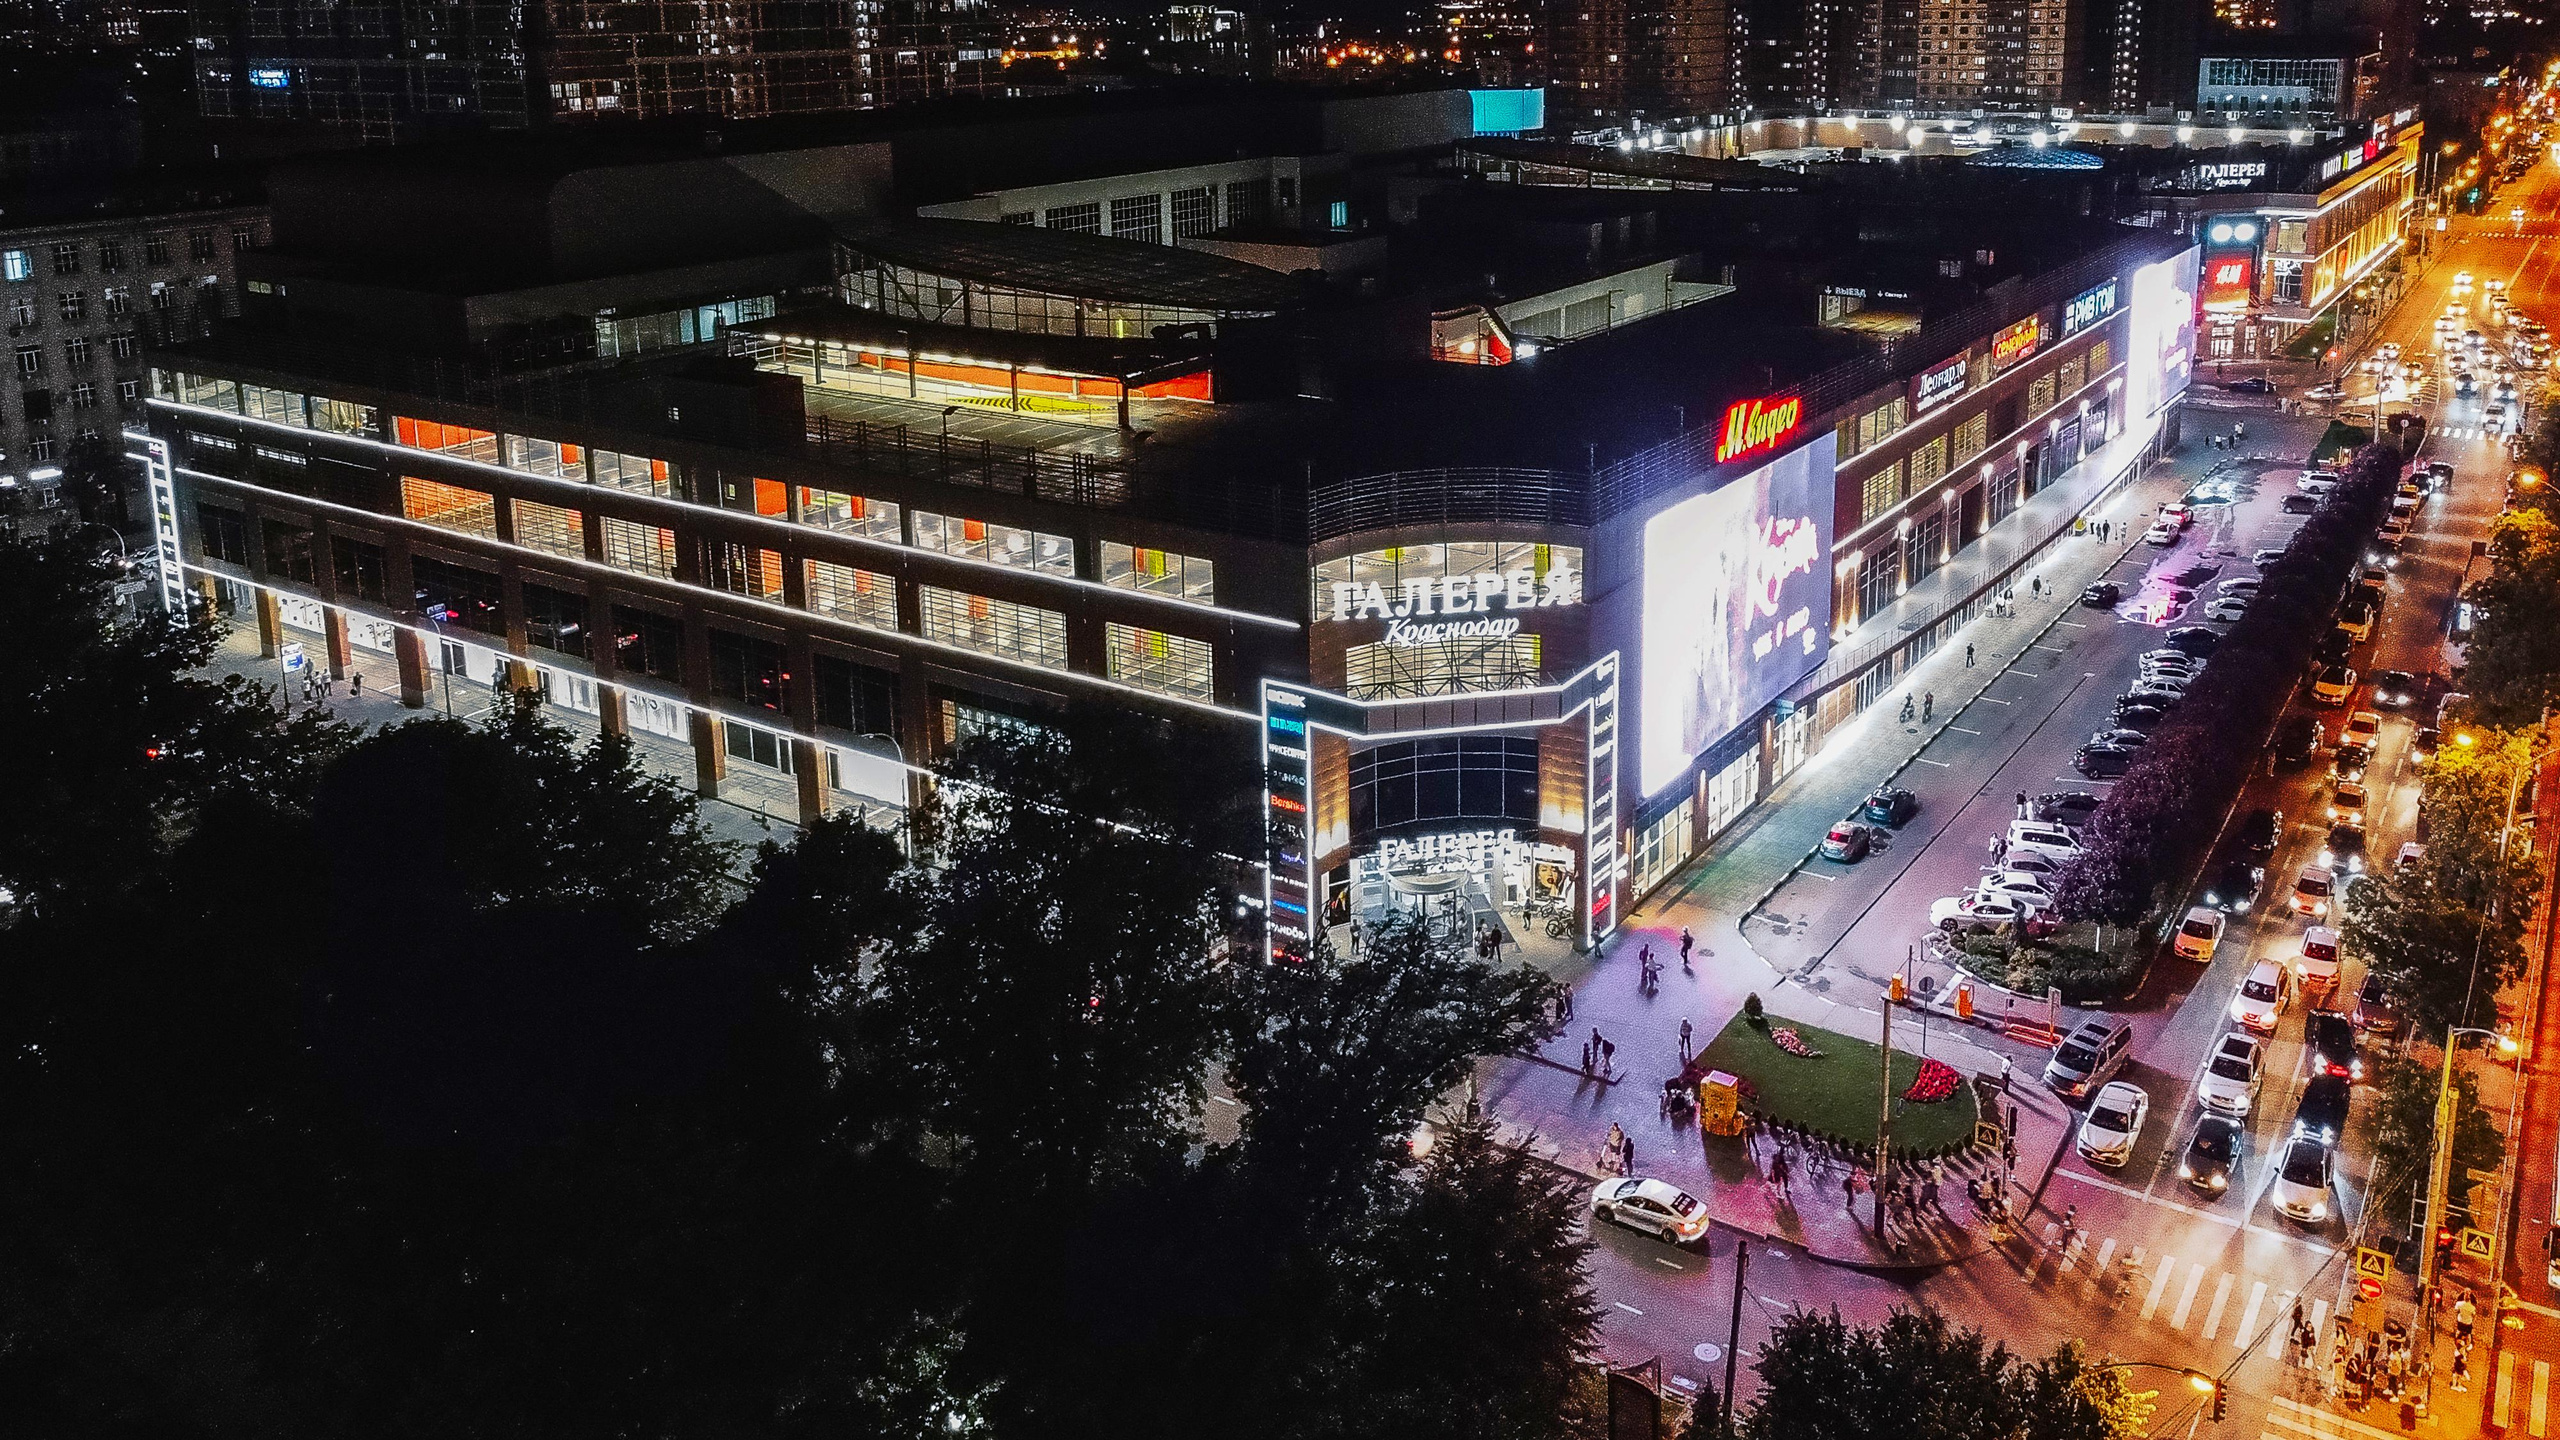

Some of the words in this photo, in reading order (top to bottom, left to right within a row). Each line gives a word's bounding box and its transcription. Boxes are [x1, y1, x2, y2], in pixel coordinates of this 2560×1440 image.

[2201, 163, 2266, 178] ГАЛЕРЕЯ
[1917, 360, 1966, 398] Леонардо
[1331, 566, 1574, 621] ГАЛЕРЕЯ
[1385, 616, 1519, 647] Краснодар
[1270, 794, 1306, 813] Bershka
[1379, 829, 1516, 866] ГАЛЕРЕЯ
